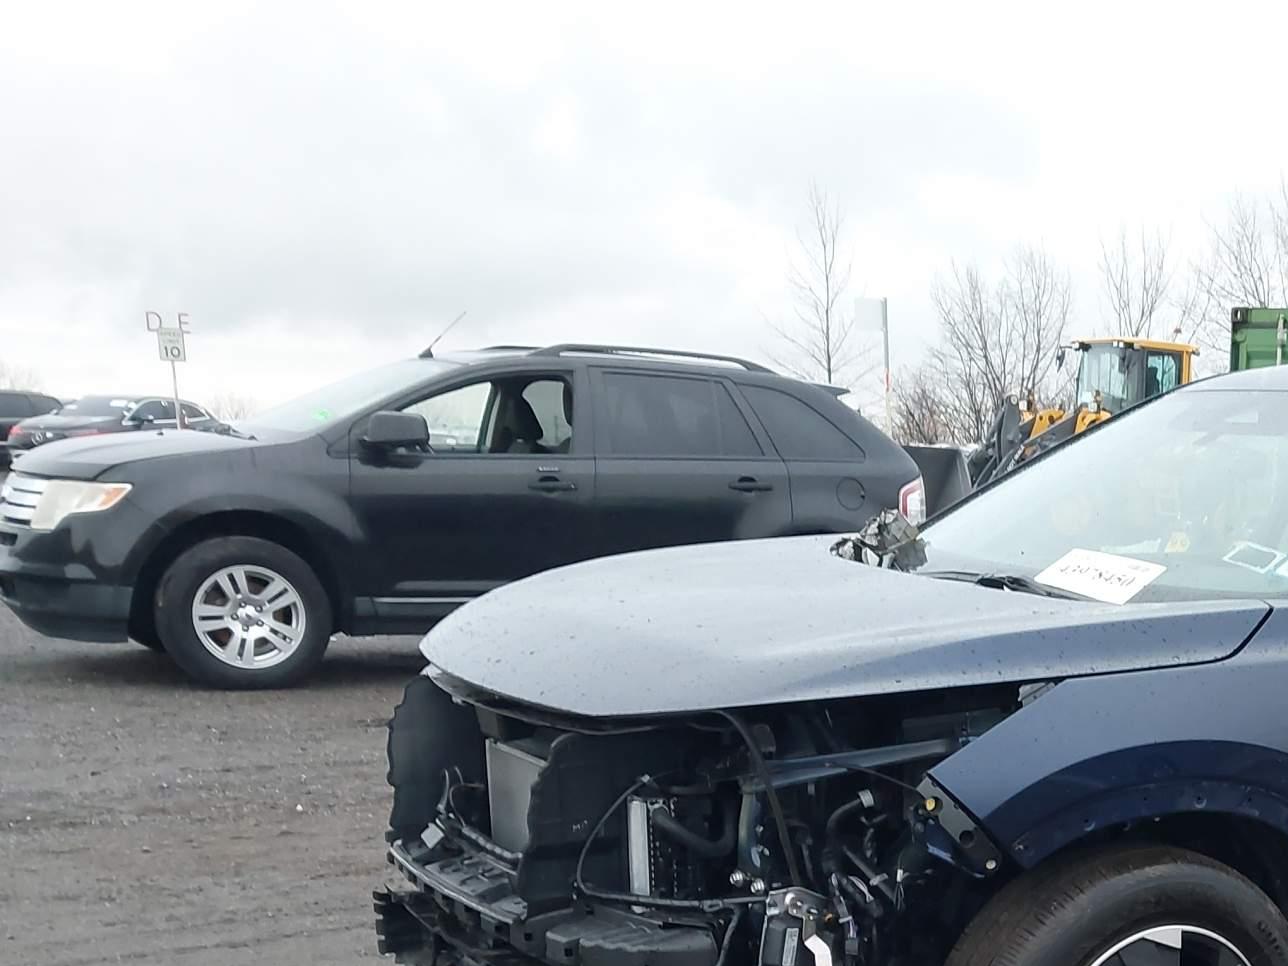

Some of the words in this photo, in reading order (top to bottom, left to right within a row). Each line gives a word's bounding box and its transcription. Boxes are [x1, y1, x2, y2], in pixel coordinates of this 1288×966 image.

[145, 311, 162, 332] D
[178, 312, 192, 334] E
[164, 345, 181, 358] 10
